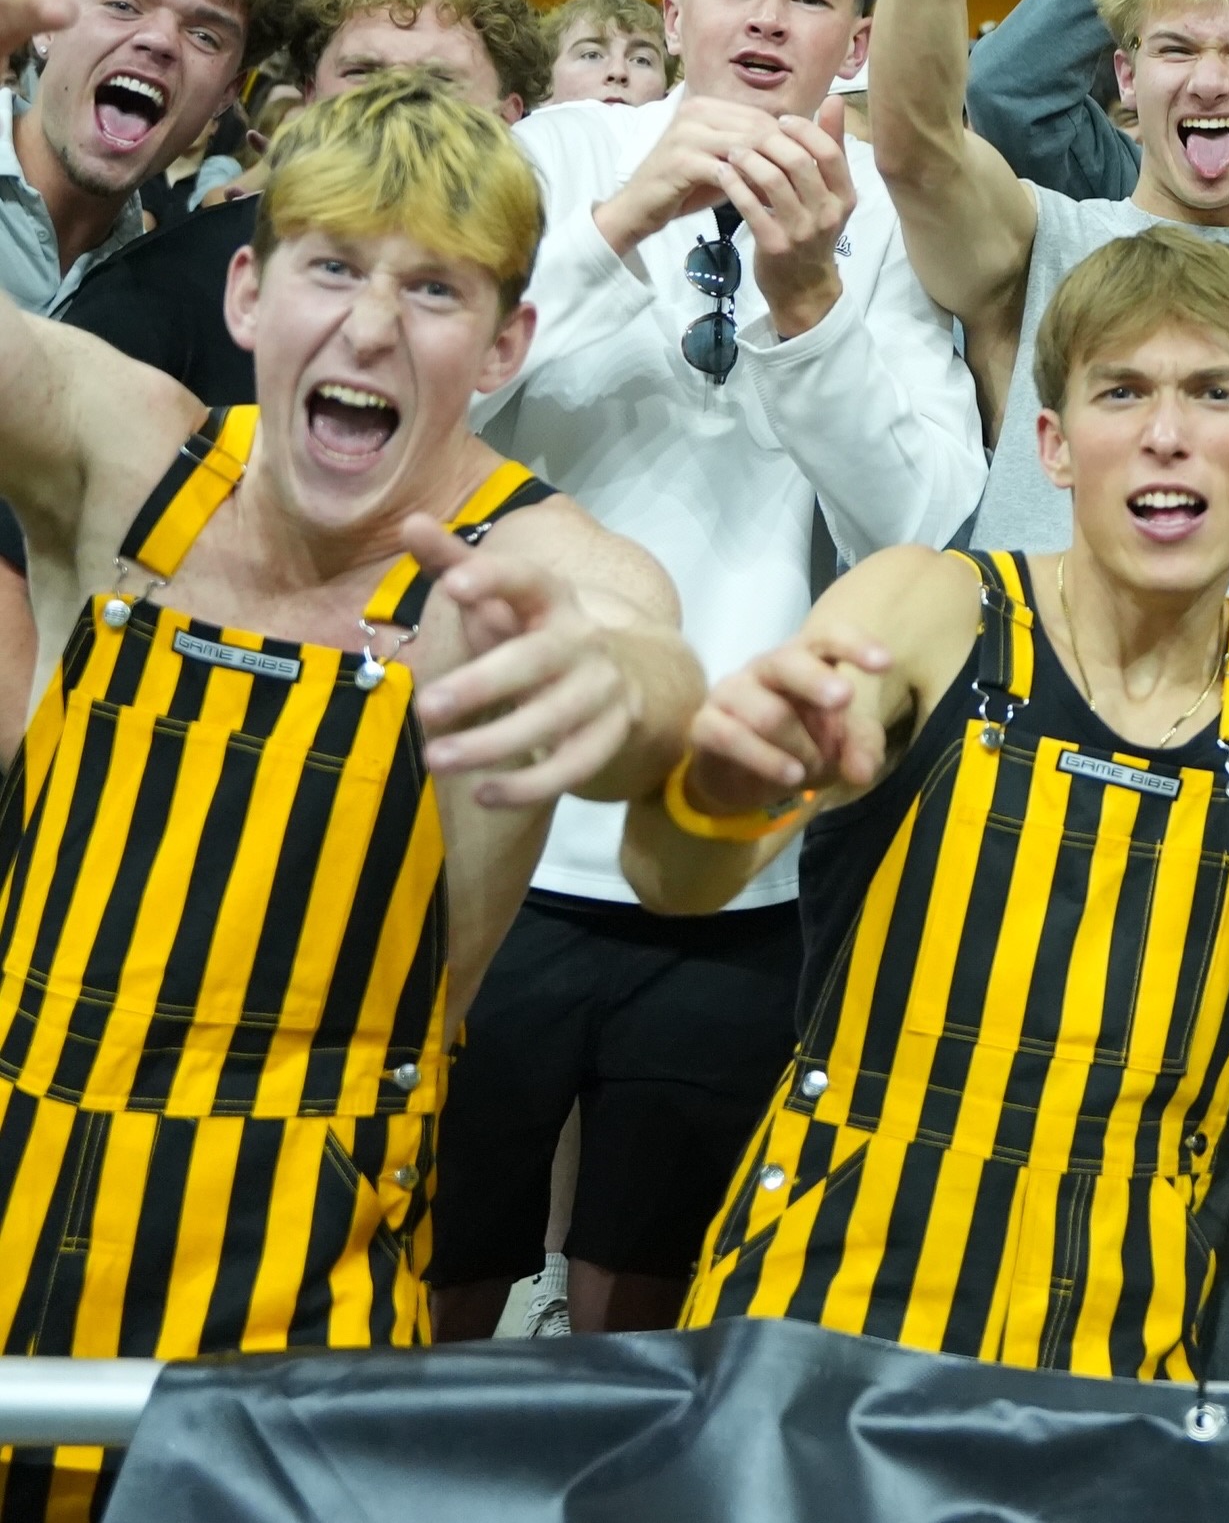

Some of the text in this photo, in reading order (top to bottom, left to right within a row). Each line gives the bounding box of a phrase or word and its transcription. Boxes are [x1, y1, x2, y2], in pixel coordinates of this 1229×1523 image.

[178, 634, 295, 674] GAME BIBS
[1065, 755, 1175, 793] GAME BIBS
